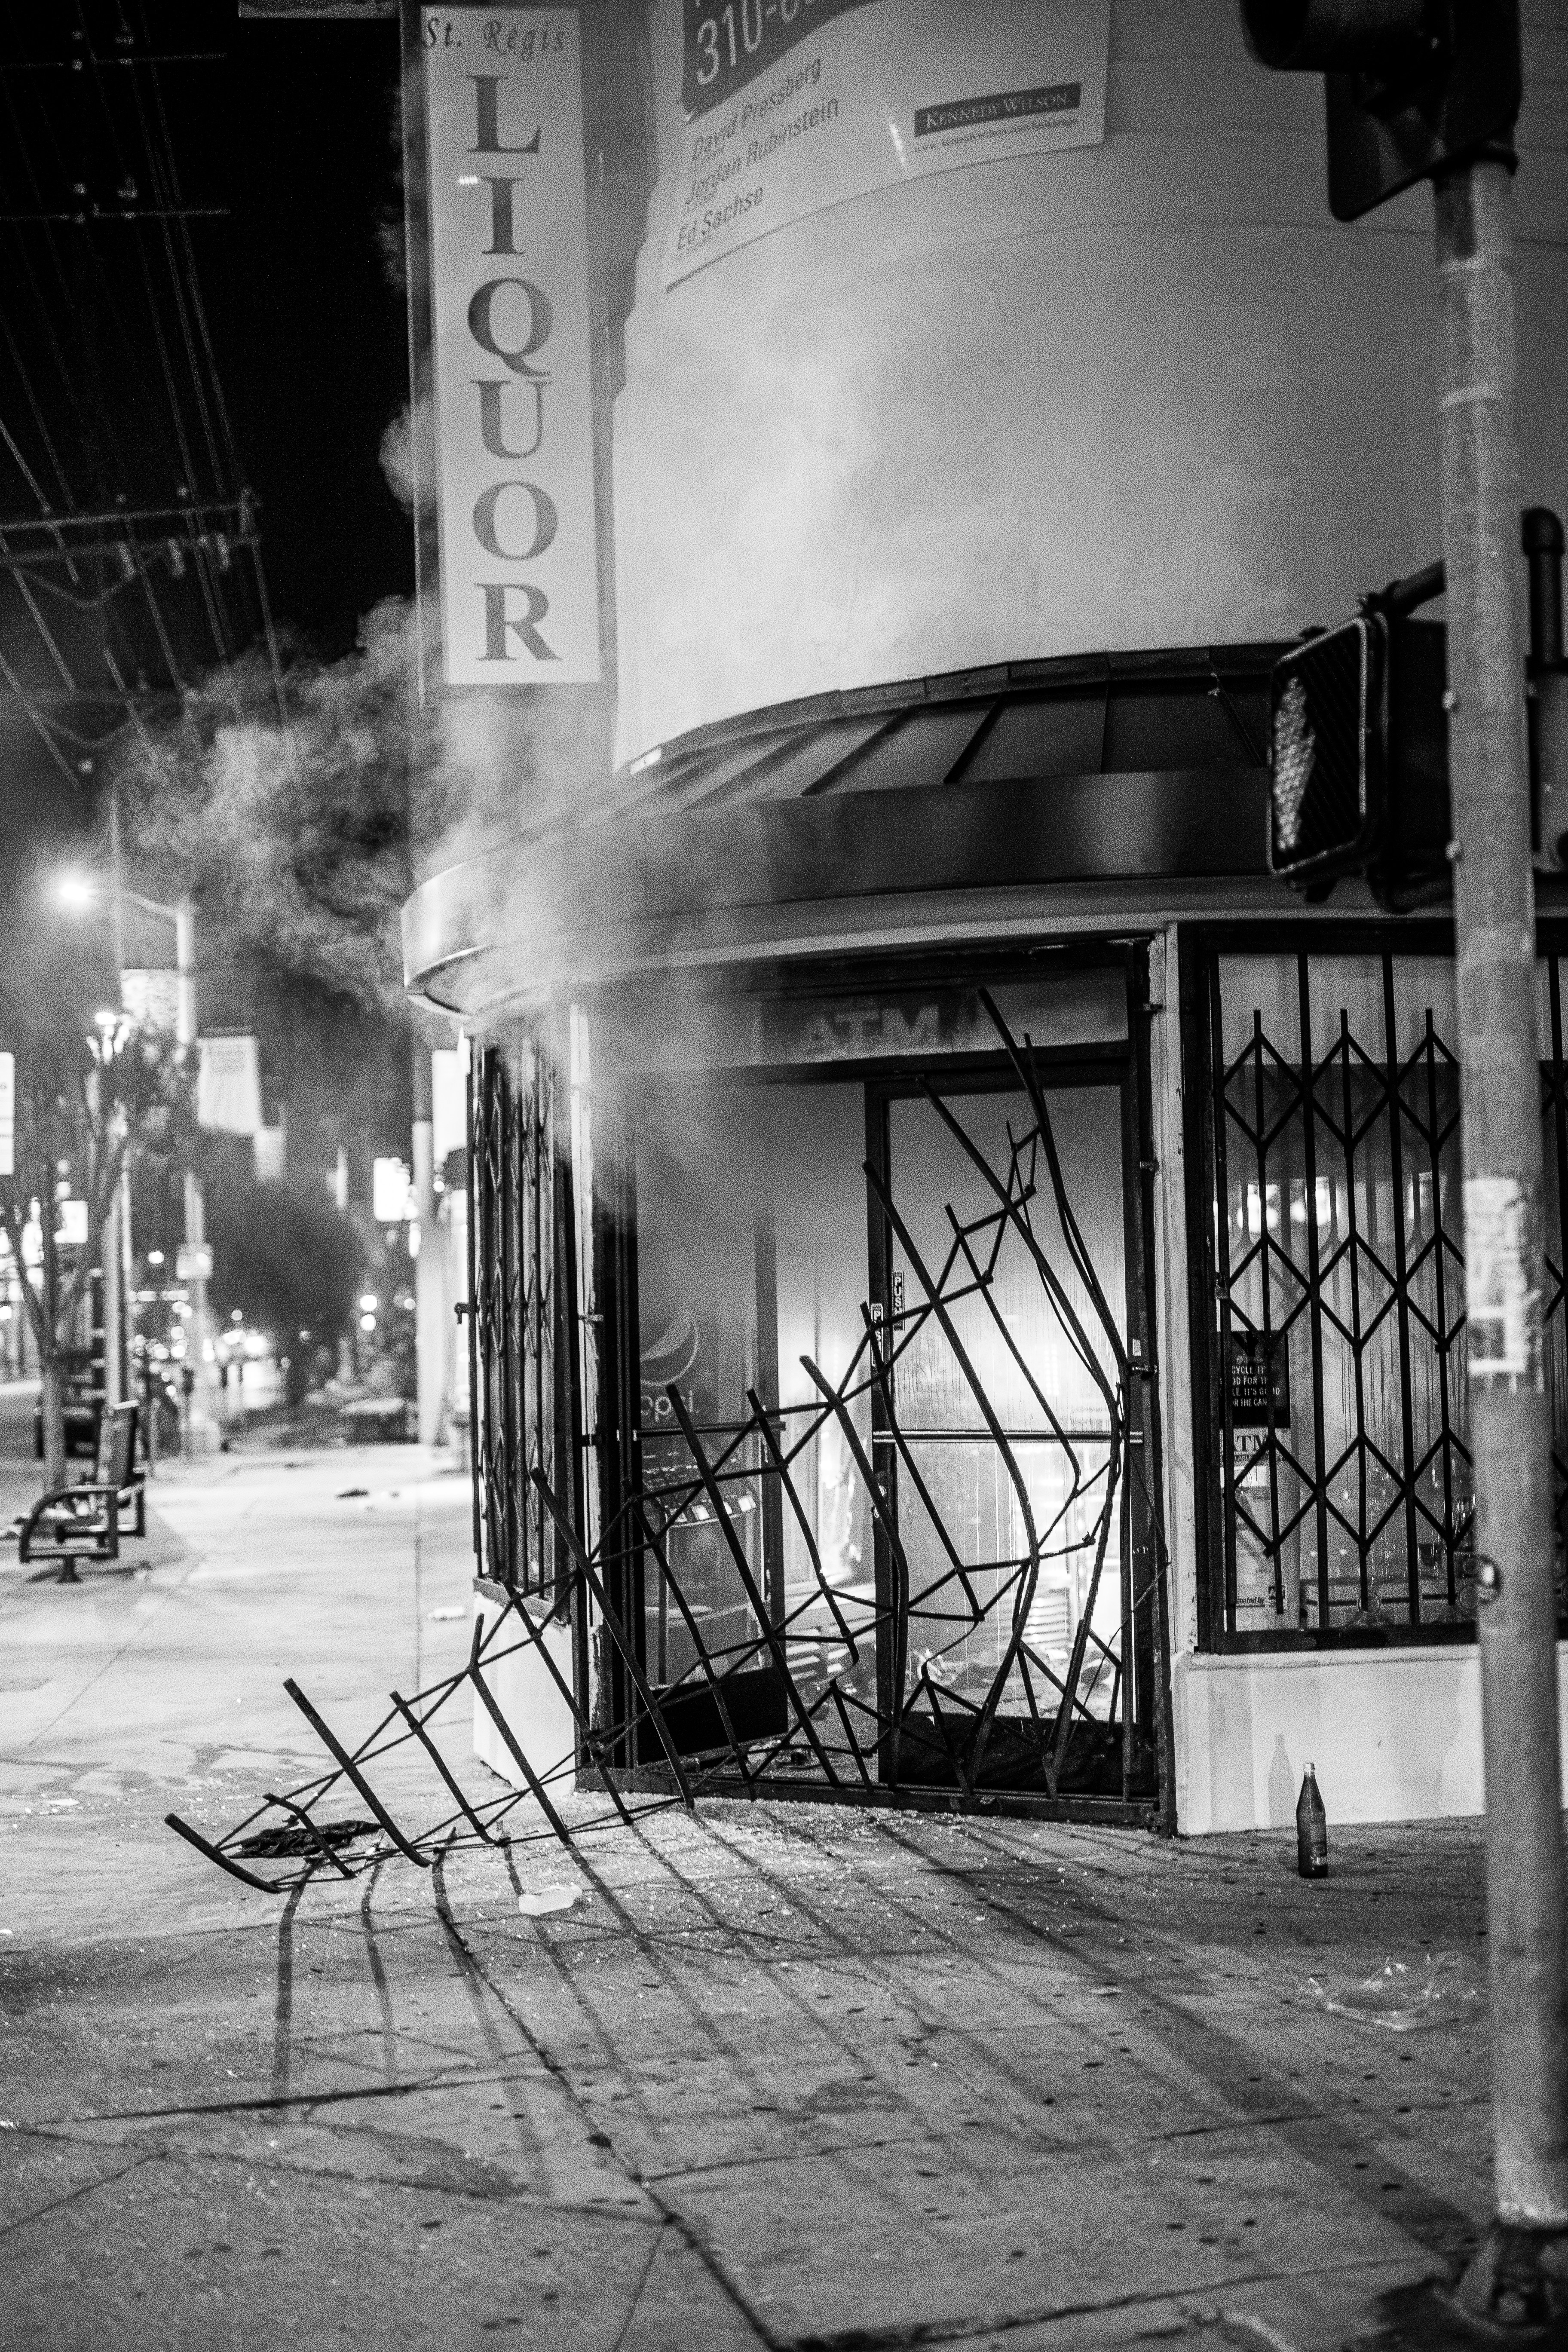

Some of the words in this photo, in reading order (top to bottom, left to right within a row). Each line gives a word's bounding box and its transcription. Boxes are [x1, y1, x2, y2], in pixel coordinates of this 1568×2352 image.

[425, 16, 462, 49] St.
[483, 20, 565, 61] Regis
[696, 0, 815, 85] 310-
[692, 112, 738, 161] David
[741, 58, 821, 130] Pressberg
[925, 103, 1000, 129] KENNEDY
[1003, 92, 1068, 113] WILSON
[685, 156, 742, 205] Jordan
[746, 97, 839, 167] Rubinstein
[677, 218, 697, 251] Ed
[701, 186, 764, 236] Sachse
[466, 74, 562, 661] LIQUOR
[802, 1004, 939, 1052] ATM
[1234, 1434, 1268, 1451] TM
